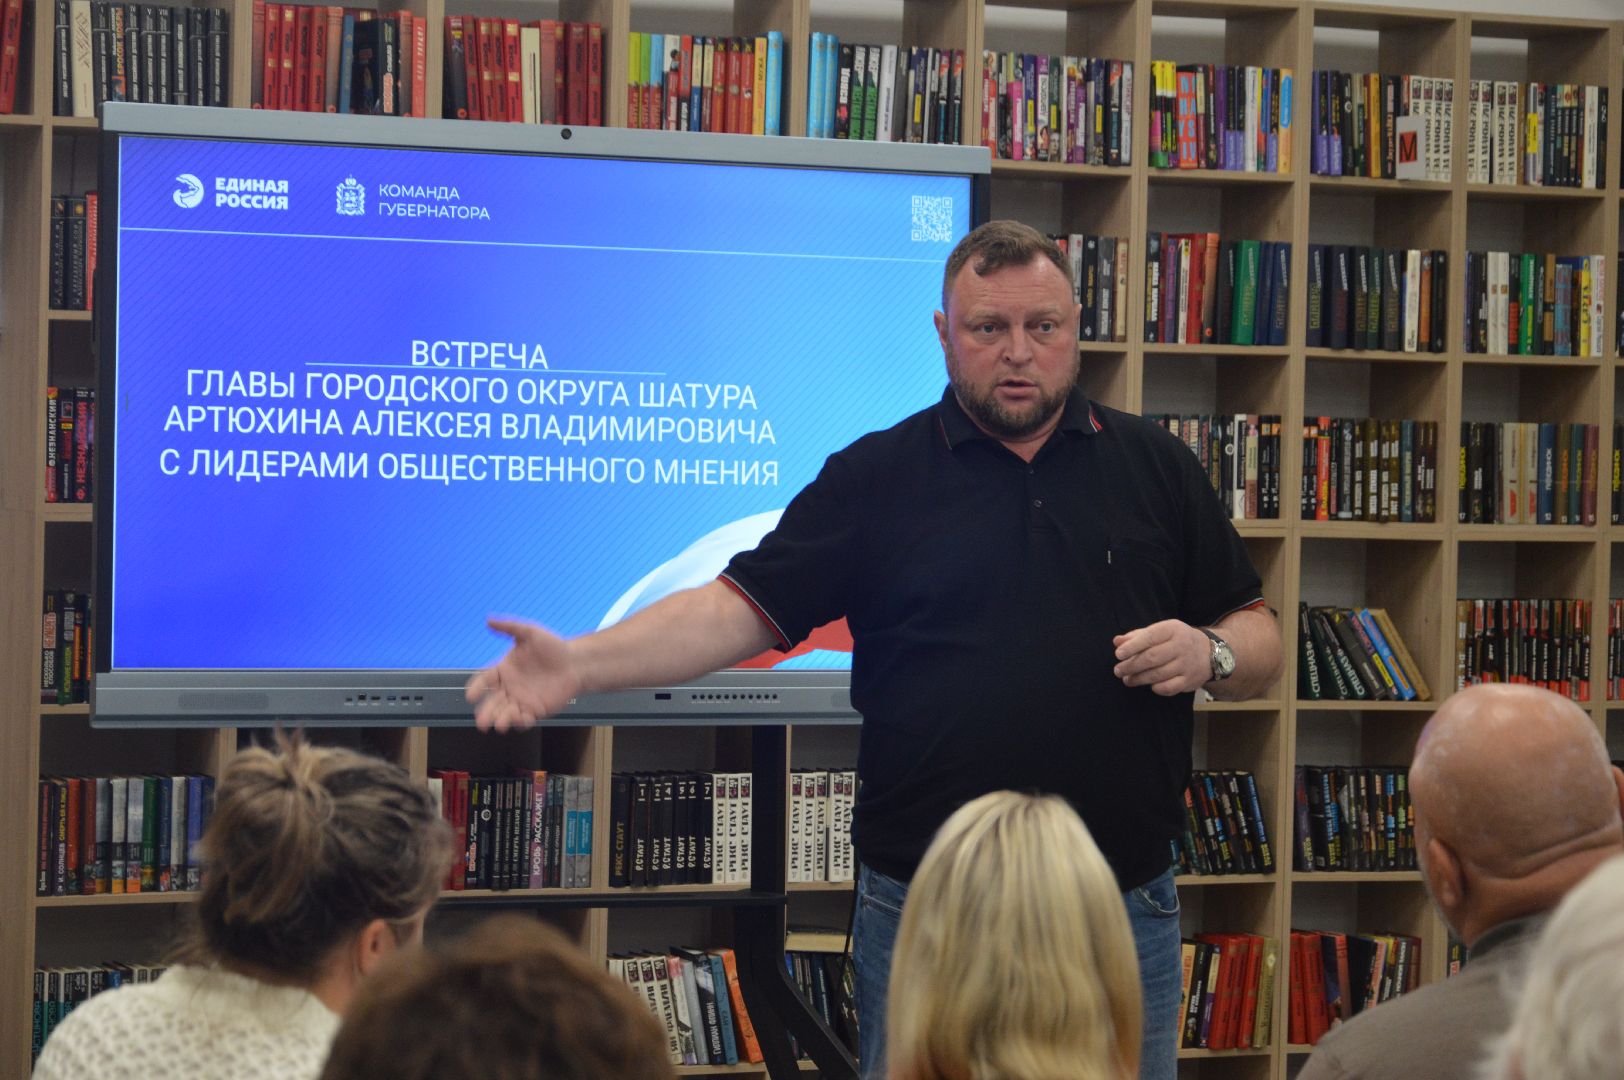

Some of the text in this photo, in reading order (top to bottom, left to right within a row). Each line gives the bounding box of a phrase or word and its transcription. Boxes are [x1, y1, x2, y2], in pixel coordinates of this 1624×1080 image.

[215, 177, 289, 195] ЕДИНАЯ
[215, 193, 289, 212] РОССИЯ
[378, 183, 460, 201] КОМАНДА
[378, 202, 491, 221] ГУБЕРНАТОРА
[410, 339, 549, 370] ВСТРЕЧА
[186, 369, 758, 411] ГЛАВЫ ГОРОДСКОГО ОКРУГА ШАТУРА
[163, 405, 776, 446] АРТЮХИНА АЛЕКСЕЯ ВЛАДИМИРОВИЧА
[159, 448, 779, 486] С ЛИДЕРАМИ ОБЩЕСТВЕННОГО МНЕНИЯ
[533, 792, 543, 875] КРОВЬ РАССКАЖЕТ
[706, 1002, 722, 1055] ГИЛЛИАН ФЛИНН
